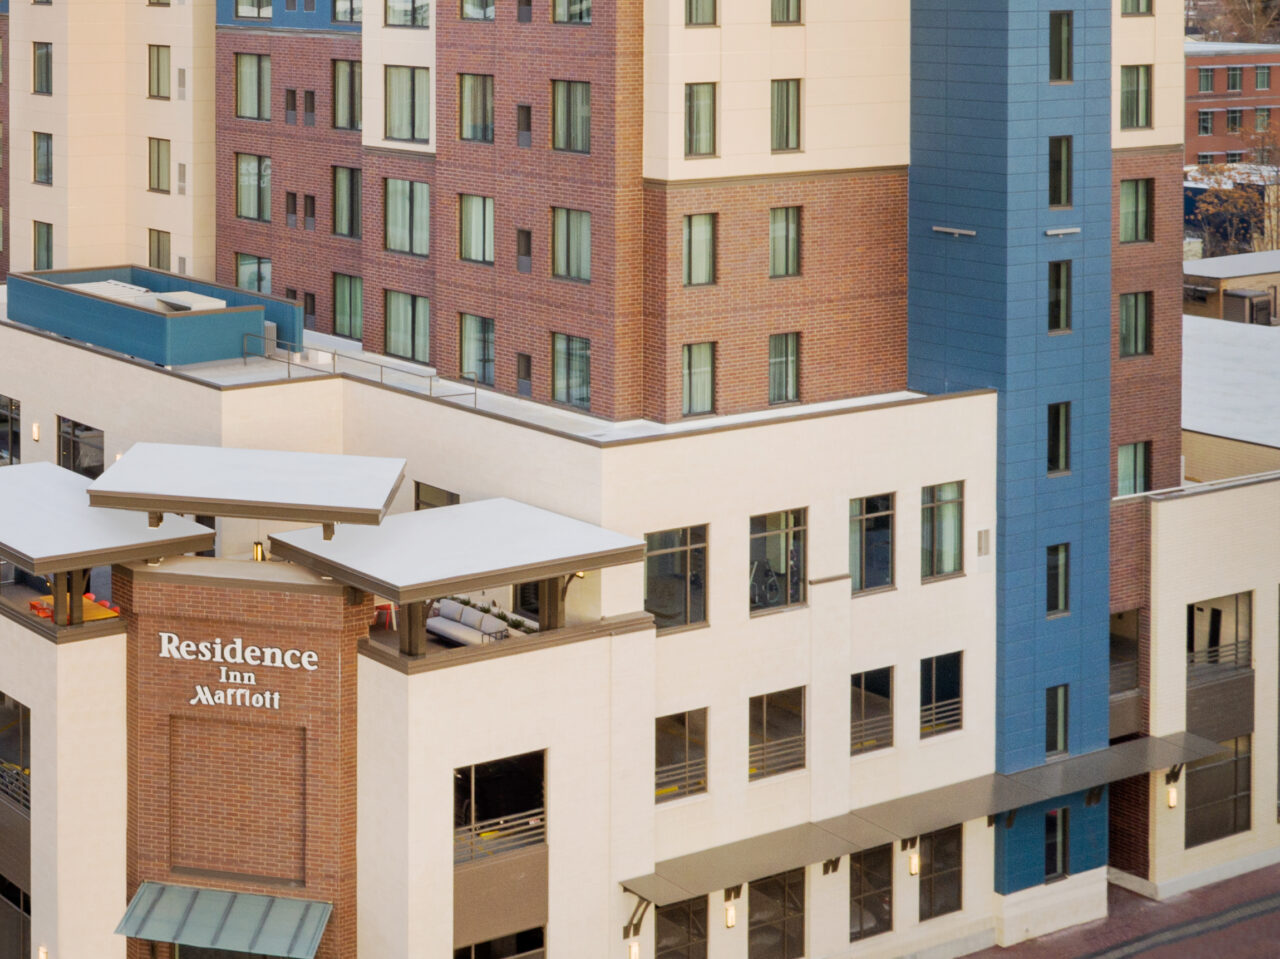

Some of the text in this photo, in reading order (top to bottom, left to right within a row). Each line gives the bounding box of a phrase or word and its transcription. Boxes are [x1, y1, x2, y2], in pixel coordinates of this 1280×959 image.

[158, 632, 319, 671] Residence
[219, 666, 257, 686] Inn
[189, 684, 281, 711] Marriott
